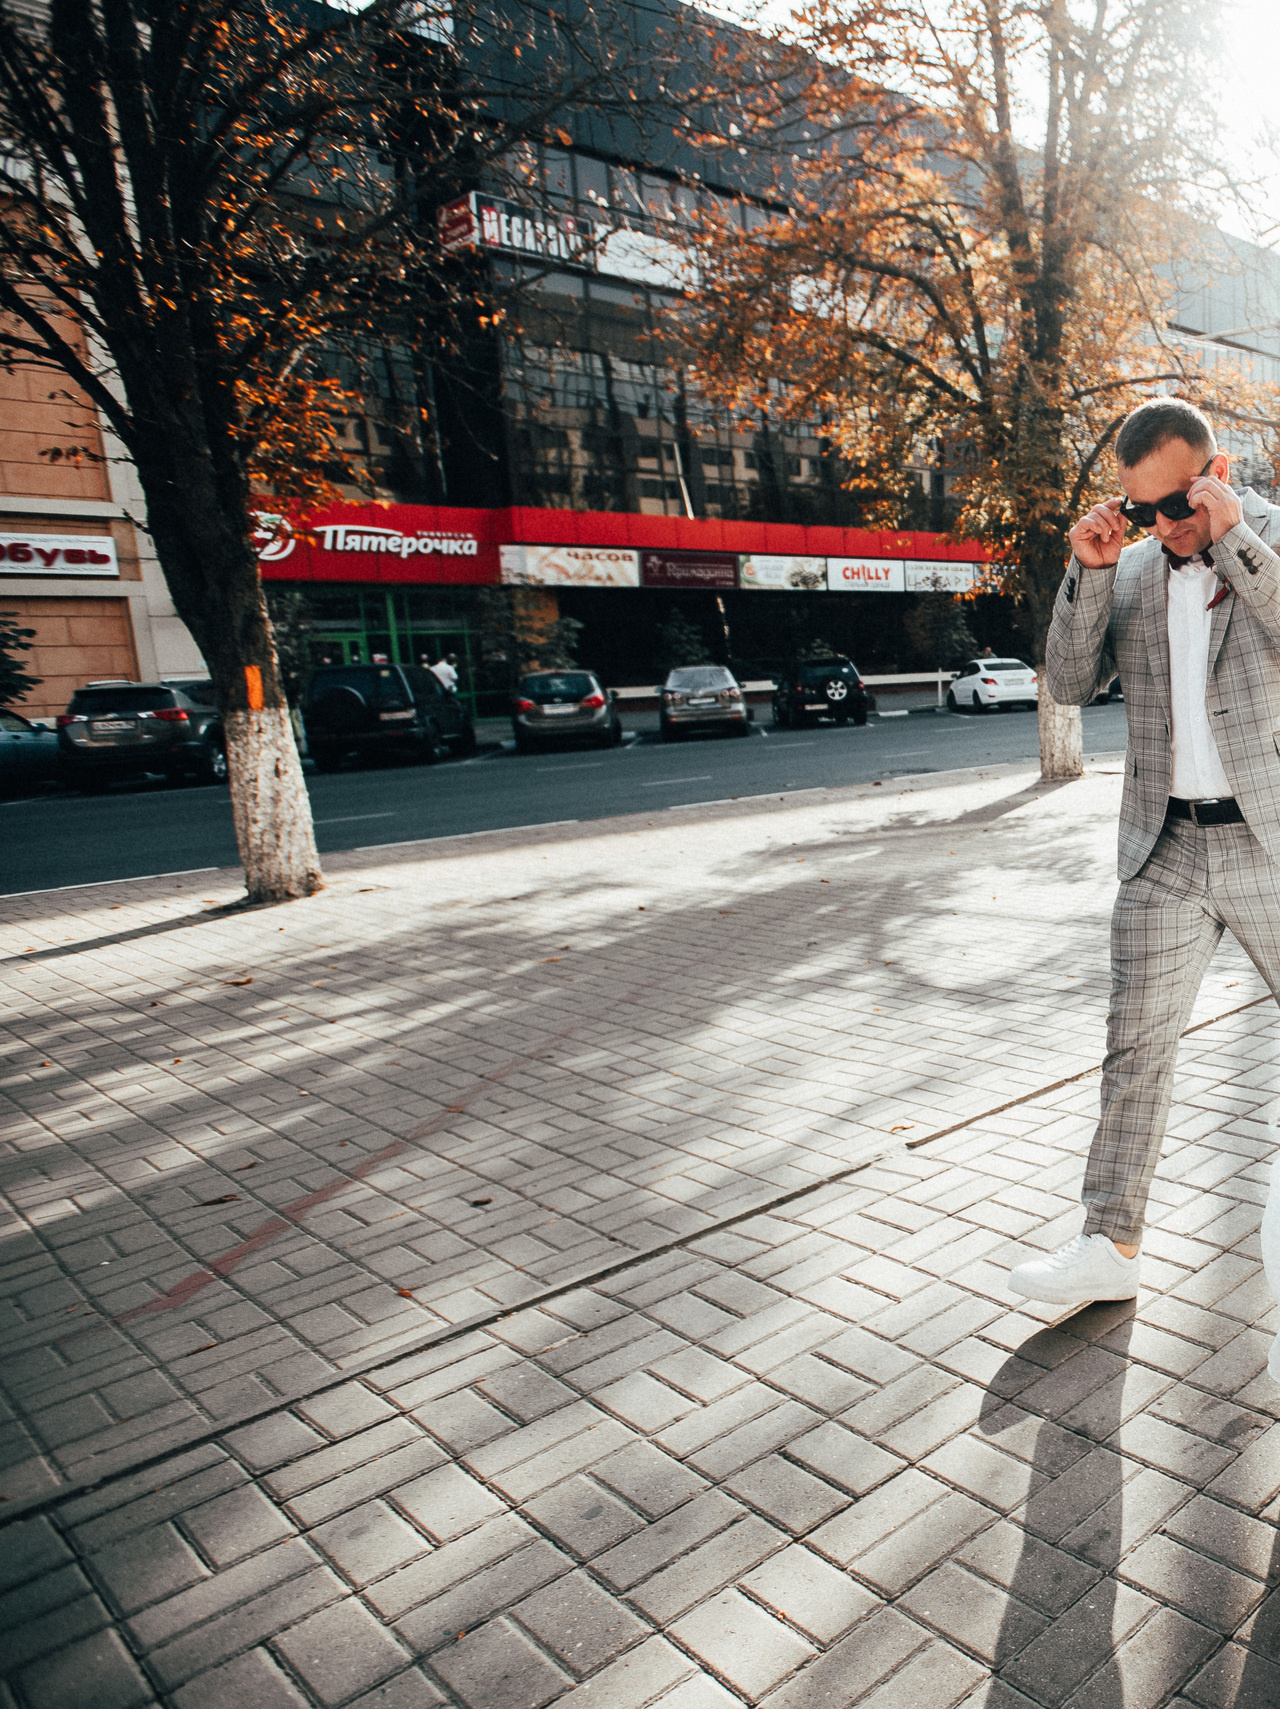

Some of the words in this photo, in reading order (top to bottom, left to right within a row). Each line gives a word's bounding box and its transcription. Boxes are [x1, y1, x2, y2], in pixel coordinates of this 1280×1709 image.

[313, 525, 477, 558] Пятерочка
[0, 542, 111, 567] бувь
[842, 564, 890, 584] CHILLY
